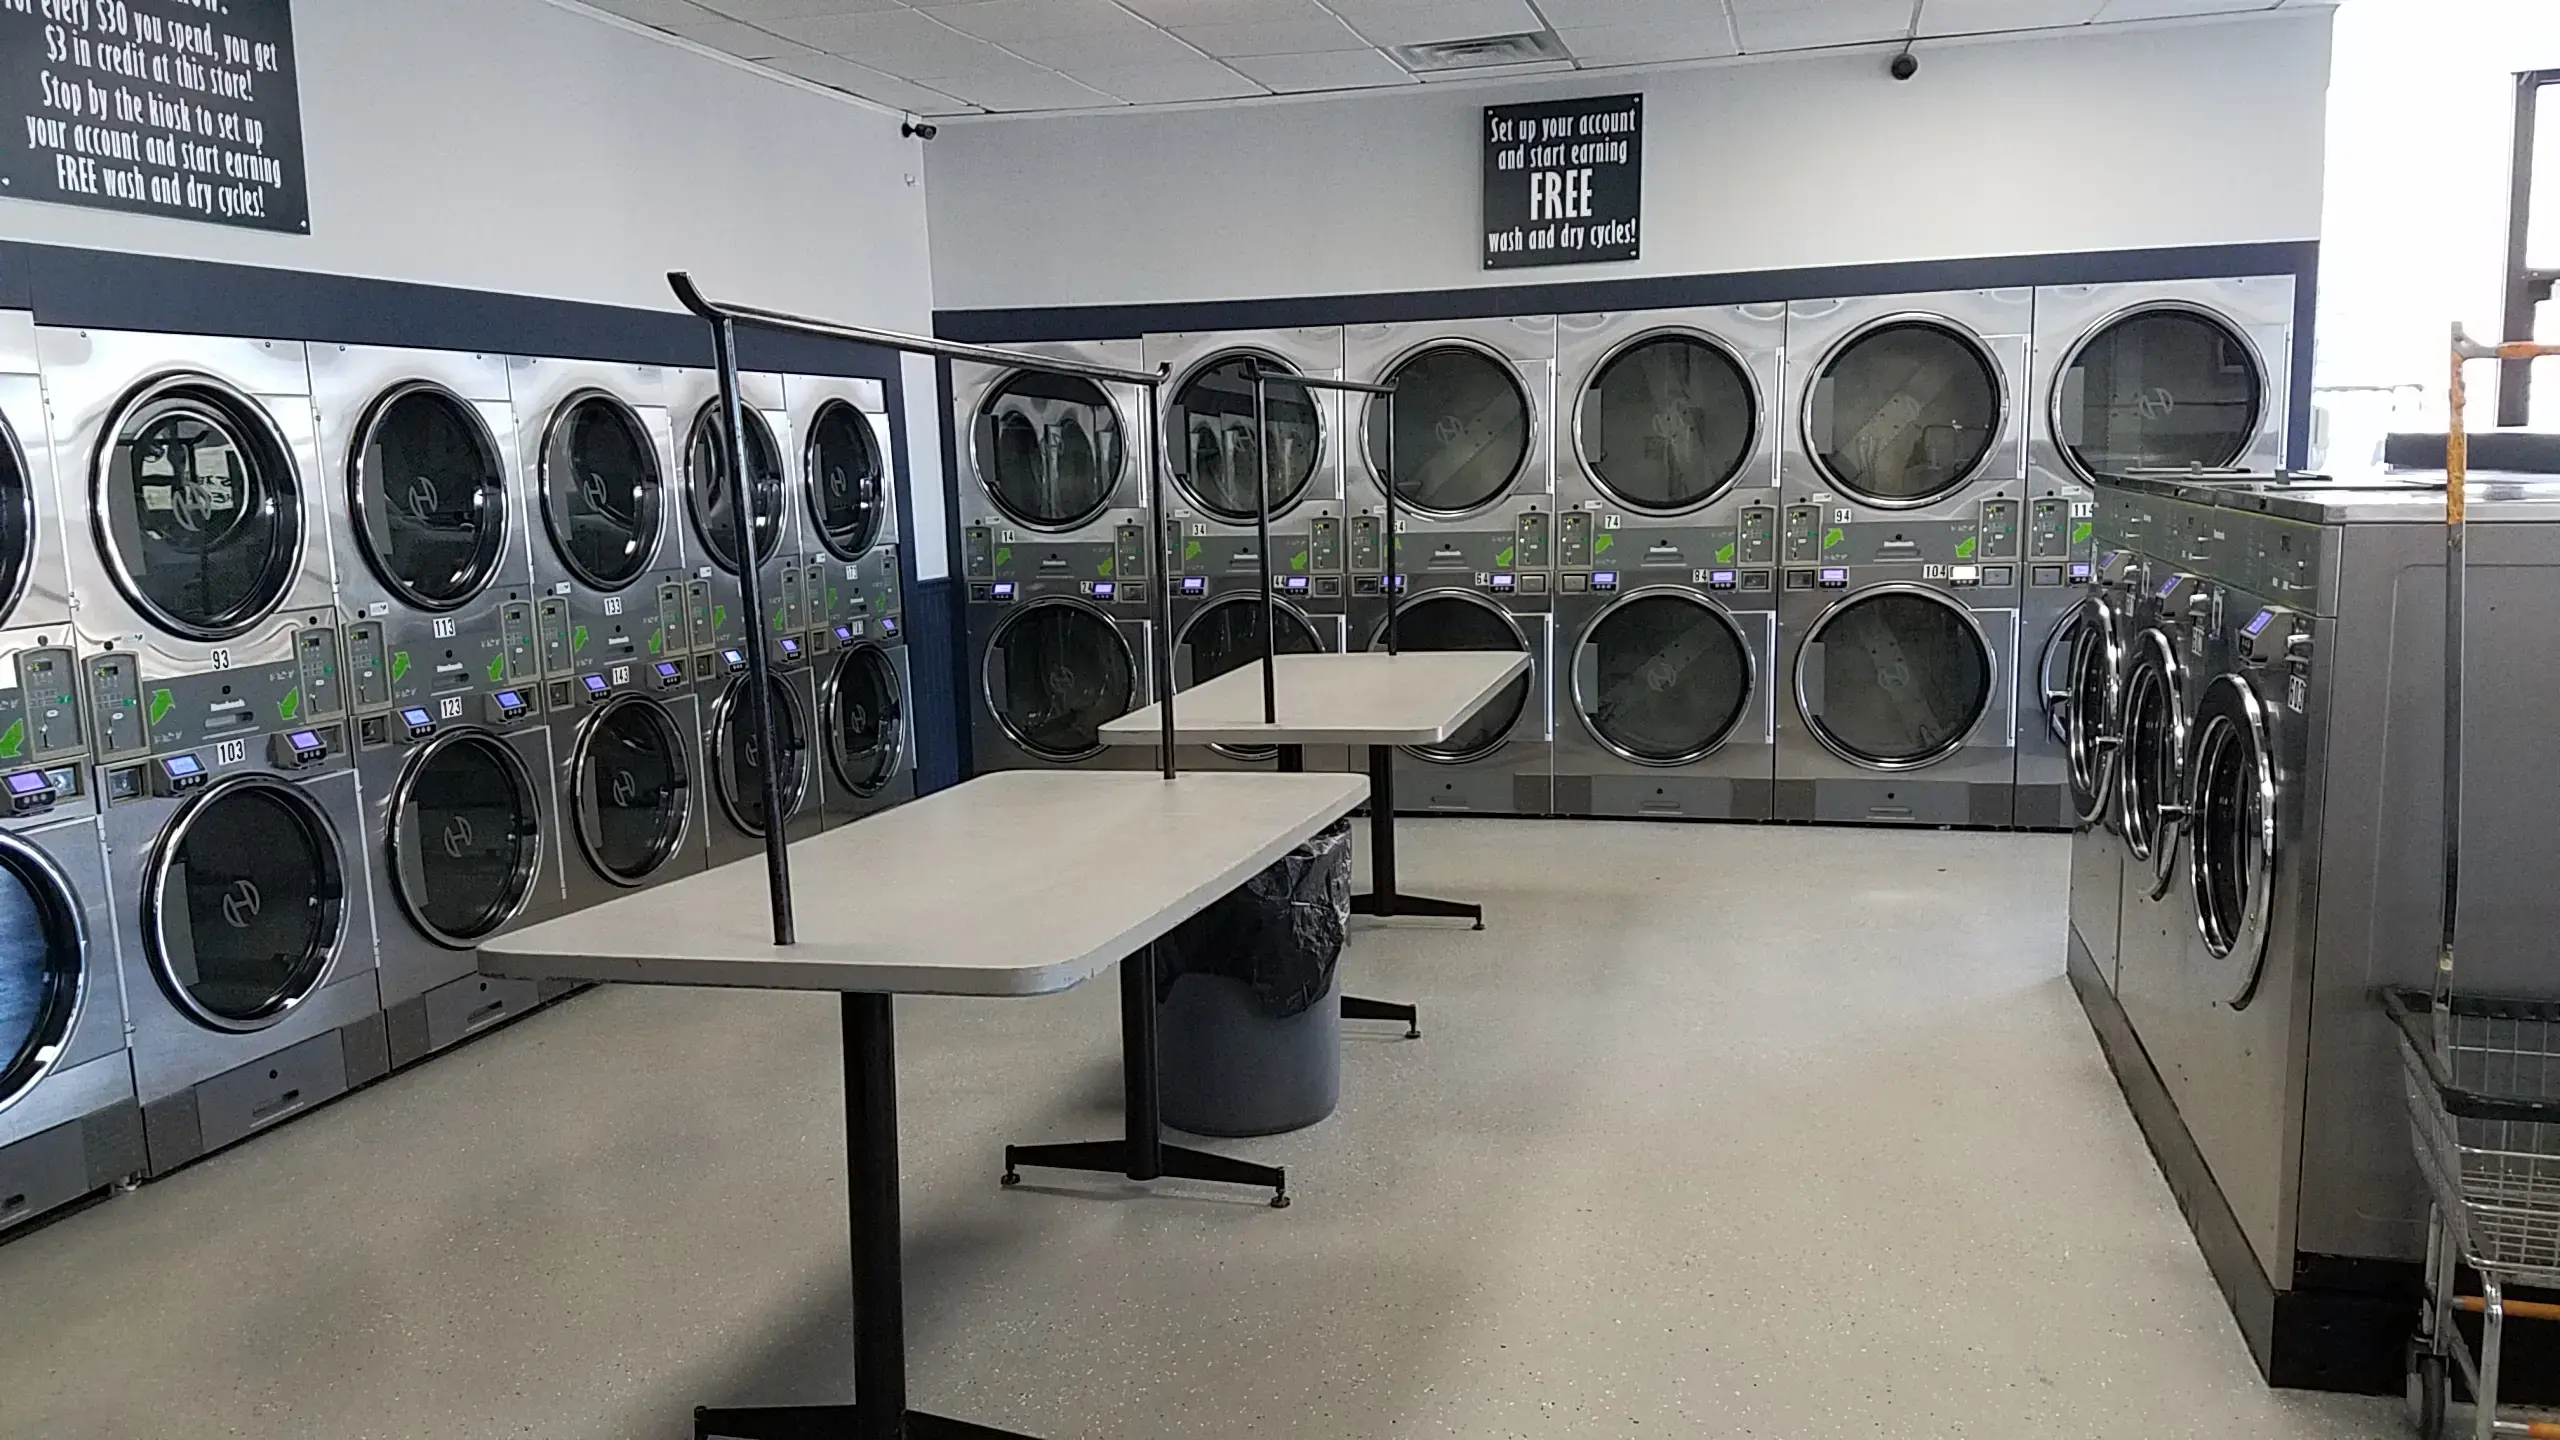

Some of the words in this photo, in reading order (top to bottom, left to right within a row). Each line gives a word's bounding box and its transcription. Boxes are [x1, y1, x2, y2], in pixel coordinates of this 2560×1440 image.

[97, 0, 128, 35] $30
[133, 12, 163, 44] you
[167, 20, 219, 61] spend,
[223, 34, 249, 65] you
[254, 43, 278, 72] get
[45, 24, 67, 63] $3
[72, 29, 92, 68] in
[97, 41, 148, 80] credit
[152, 53, 171, 85] at
[175, 53, 206, 92] this
[210, 68, 253, 101] store!
[40, 70, 82, 116] Stop
[88, 79, 107, 121] by
[114, 86, 144, 124] the
[149, 91, 191, 133] kiosk
[195, 104, 213, 137] to
[218, 110, 239, 142] set
[245, 118, 263, 150] up
[1491, 117, 1513, 142] Set
[1519, 119, 1536, 143] up
[1542, 116, 1574, 141] your
[1579, 108, 1635, 135] account
[26, 115, 67, 149] your
[74, 123, 141, 162] account
[146, 133, 177, 167] and
[182, 140, 221, 175] start
[225, 147, 281, 188] earning
[1498, 144, 1524, 170] and
[1530, 142, 1565, 168] start
[1571, 137, 1627, 165] earning
[56, 154, 98, 194] FREE
[103, 166, 146, 201] wash
[151, 172, 181, 205] and
[187, 175, 212, 214] dry
[218, 182, 265, 217] cycles!
[1530, 168, 1592, 220] FREE
[1489, 226, 1523, 252] wash
[1529, 224, 1554, 250] and
[1561, 222, 1584, 250] dry
[1590, 218, 1636, 248] cycles!
[1607, 516, 1619, 527] 74
[1836, 510, 1850, 521] 94
[1003, 531, 1014, 542] 14
[1194, 524, 1205, 535] 34
[1477, 573, 1488, 584] 64
[1926, 566, 1945, 578] 104
[606, 599, 621, 614] 133
[435, 619, 454, 636] 113
[213, 650, 230, 669] 93
[614, 668, 629, 684] 143
[442, 698, 461, 717] 123
[220, 741, 244, 763] 103
